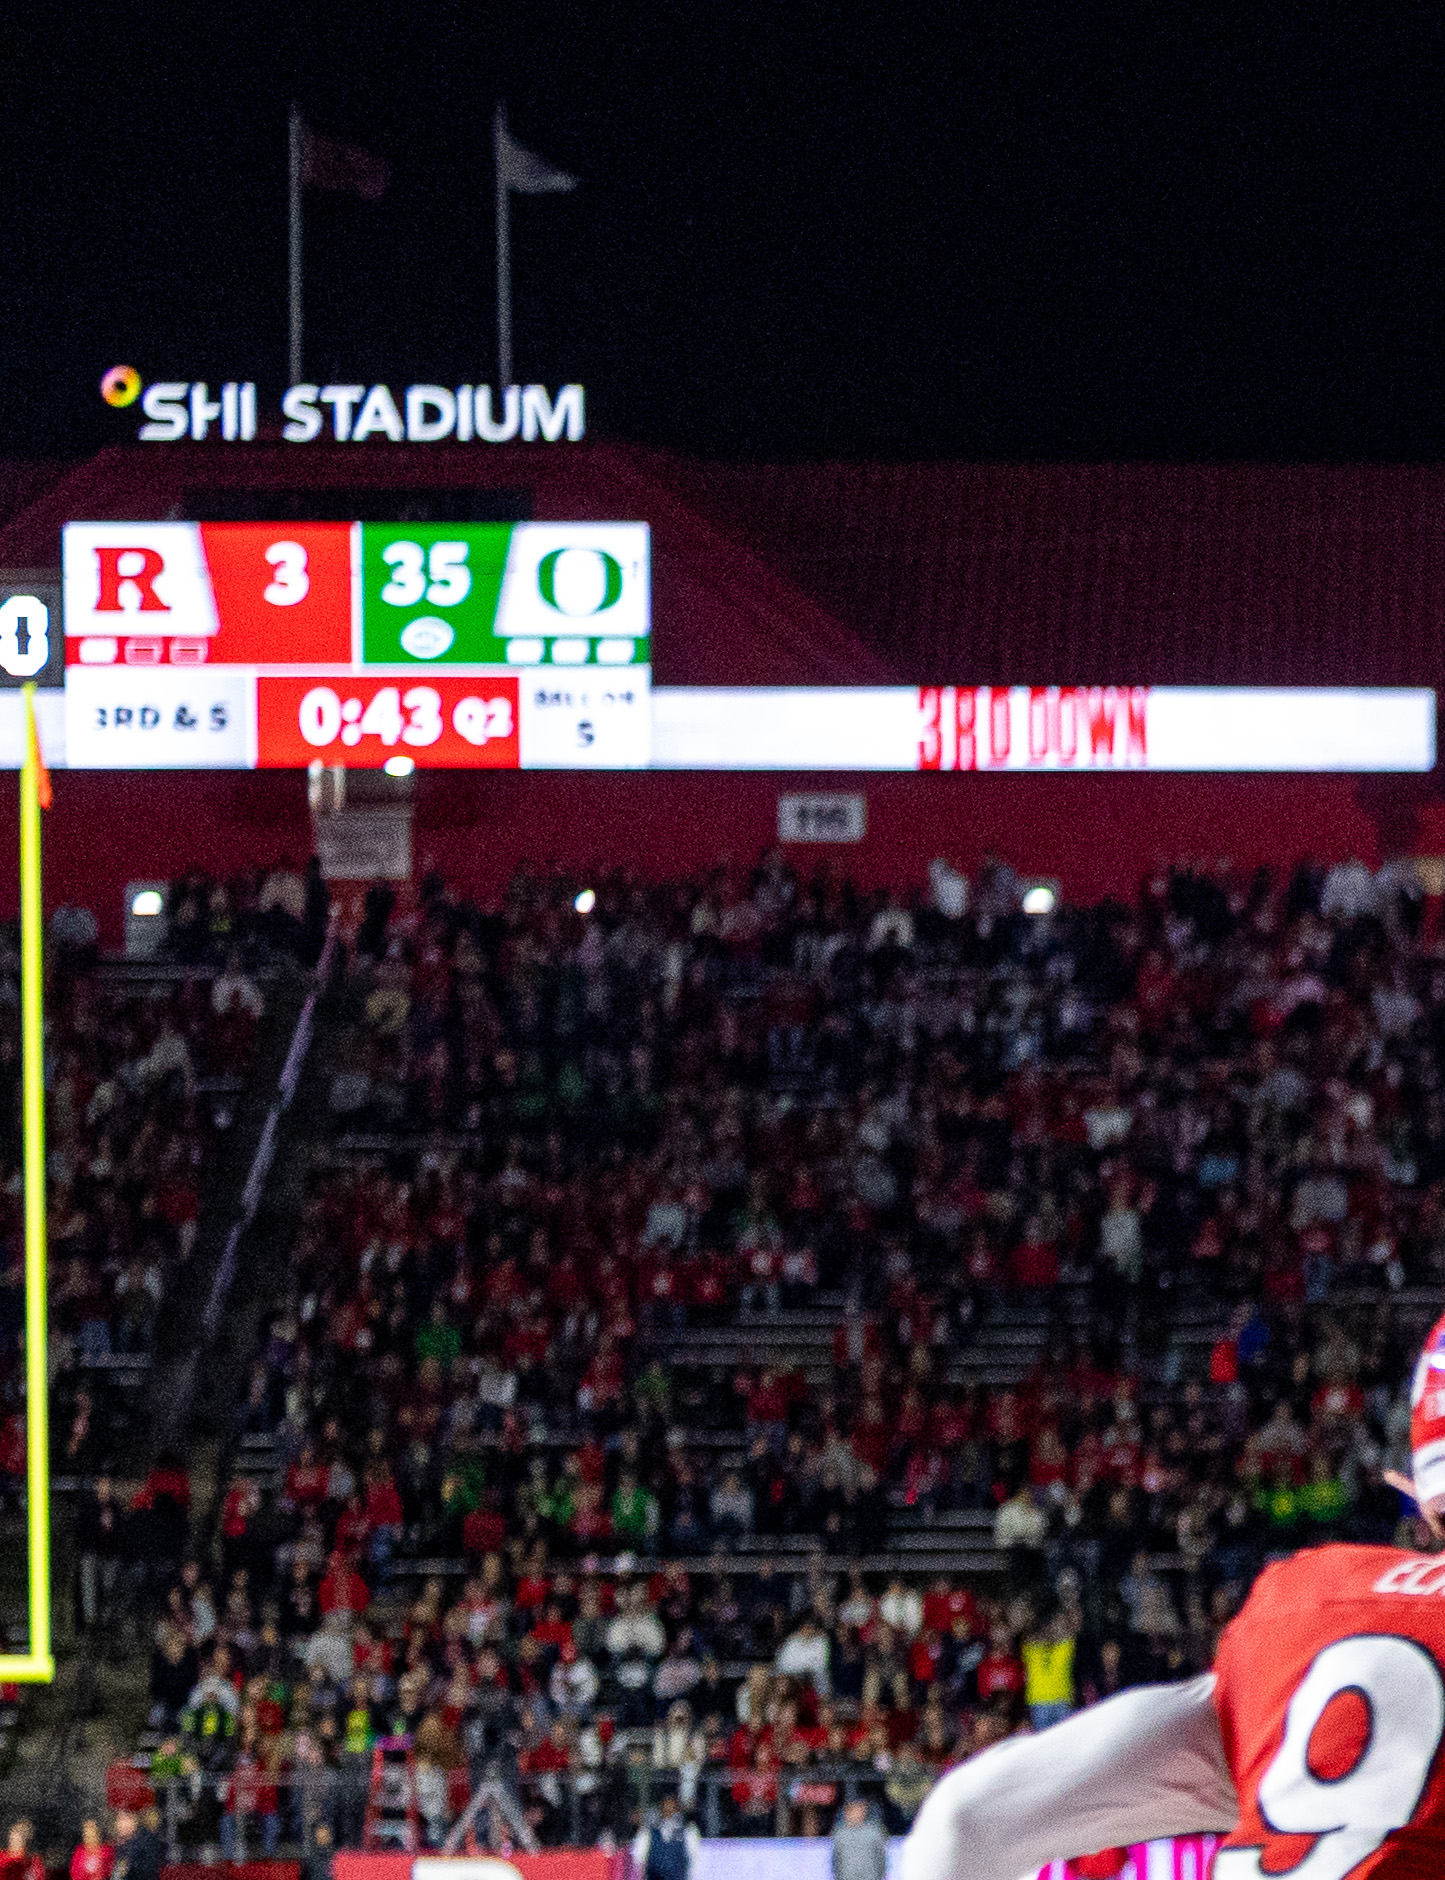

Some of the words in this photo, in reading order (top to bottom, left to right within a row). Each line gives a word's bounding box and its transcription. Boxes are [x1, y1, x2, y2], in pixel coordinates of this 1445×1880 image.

[138, 382, 257, 442] SHI
[282, 384, 586, 442] STADIUM
[93, 547, 172, 611] R
[264, 541, 309, 606] 3
[381, 541, 472, 606] 35
[537, 547, 623, 616] O
[299, 687, 444, 747] 0:43
[917, 686, 1010, 770] 3RD
[1028, 686, 1148, 768] DOWN
